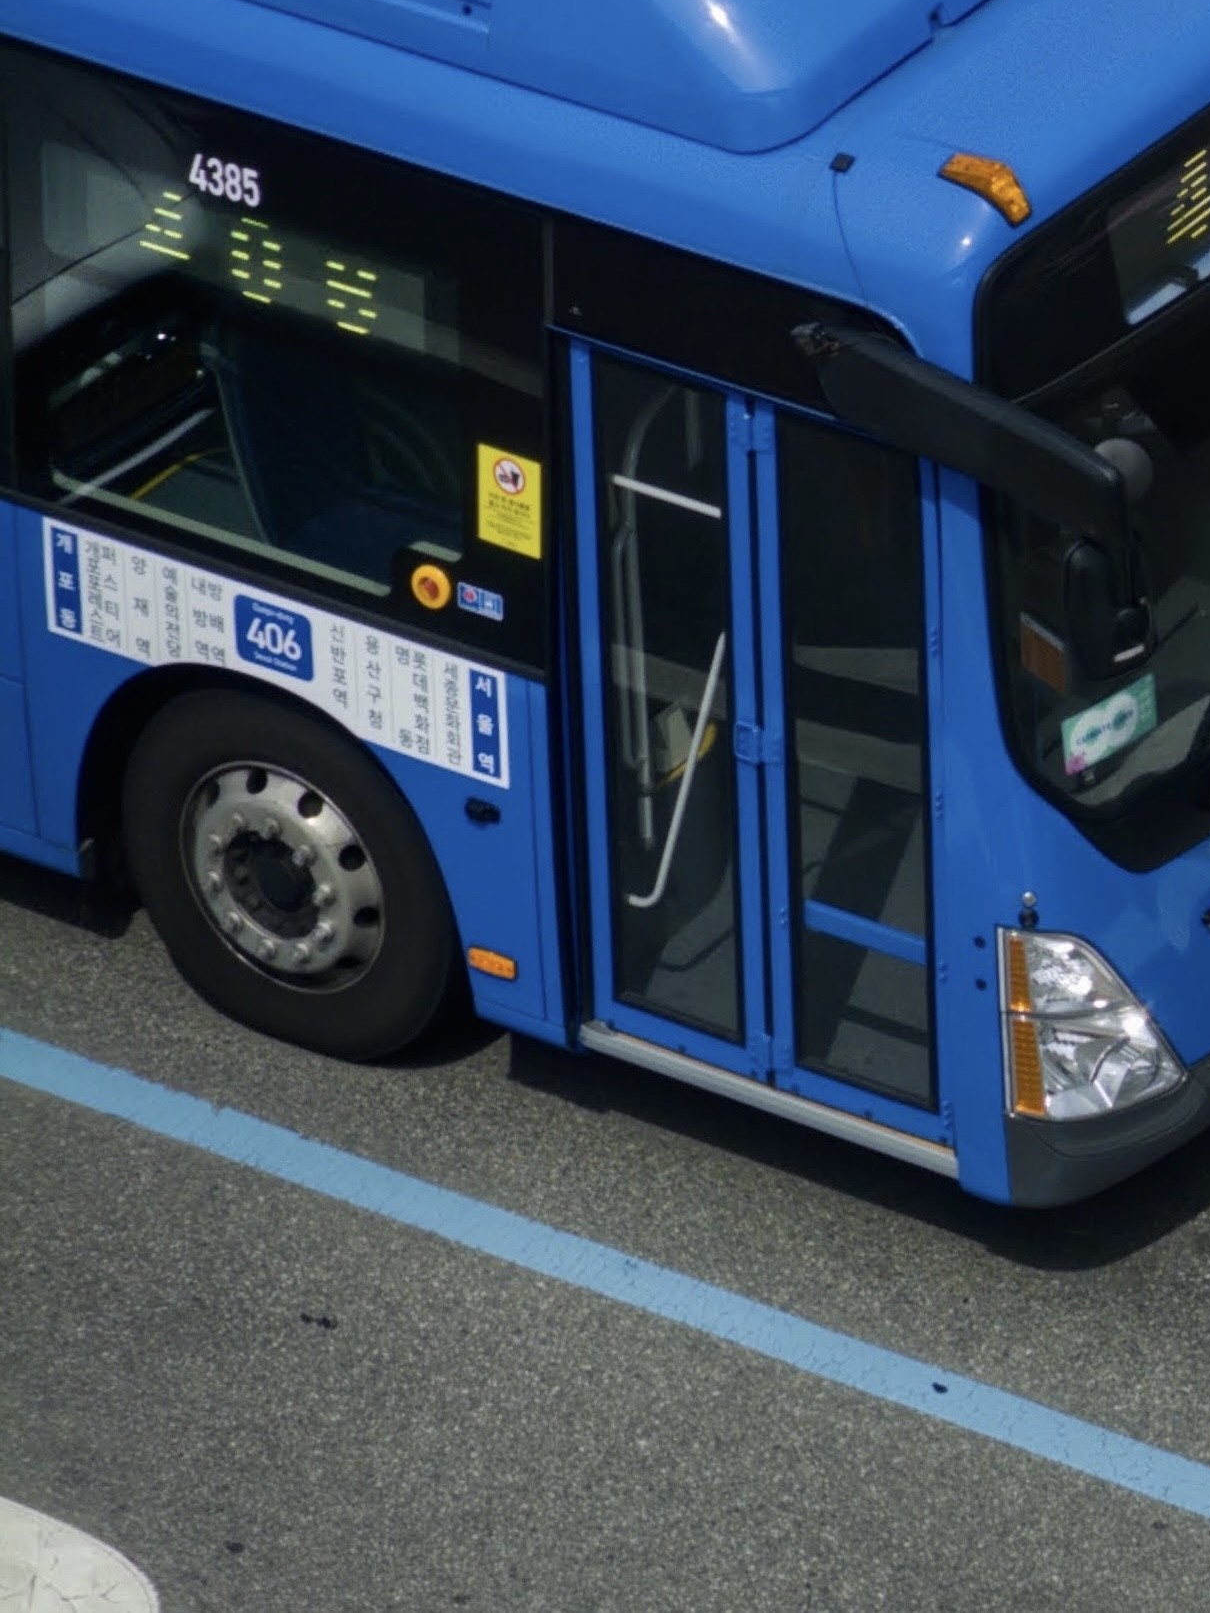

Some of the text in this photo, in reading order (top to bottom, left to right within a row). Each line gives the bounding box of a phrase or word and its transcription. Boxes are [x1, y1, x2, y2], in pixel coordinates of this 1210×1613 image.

[188, 153, 261, 207] 4385
[56, 532, 76, 629] 개포동
[131, 555, 151, 658] 양재역
[162, 566, 181, 658] 예술의전당
[246, 618, 302, 661] 406
[329, 623, 347, 708] 신반포역
[365, 635, 383, 730] 용산구청
[475, 676, 495, 774] 서울역
